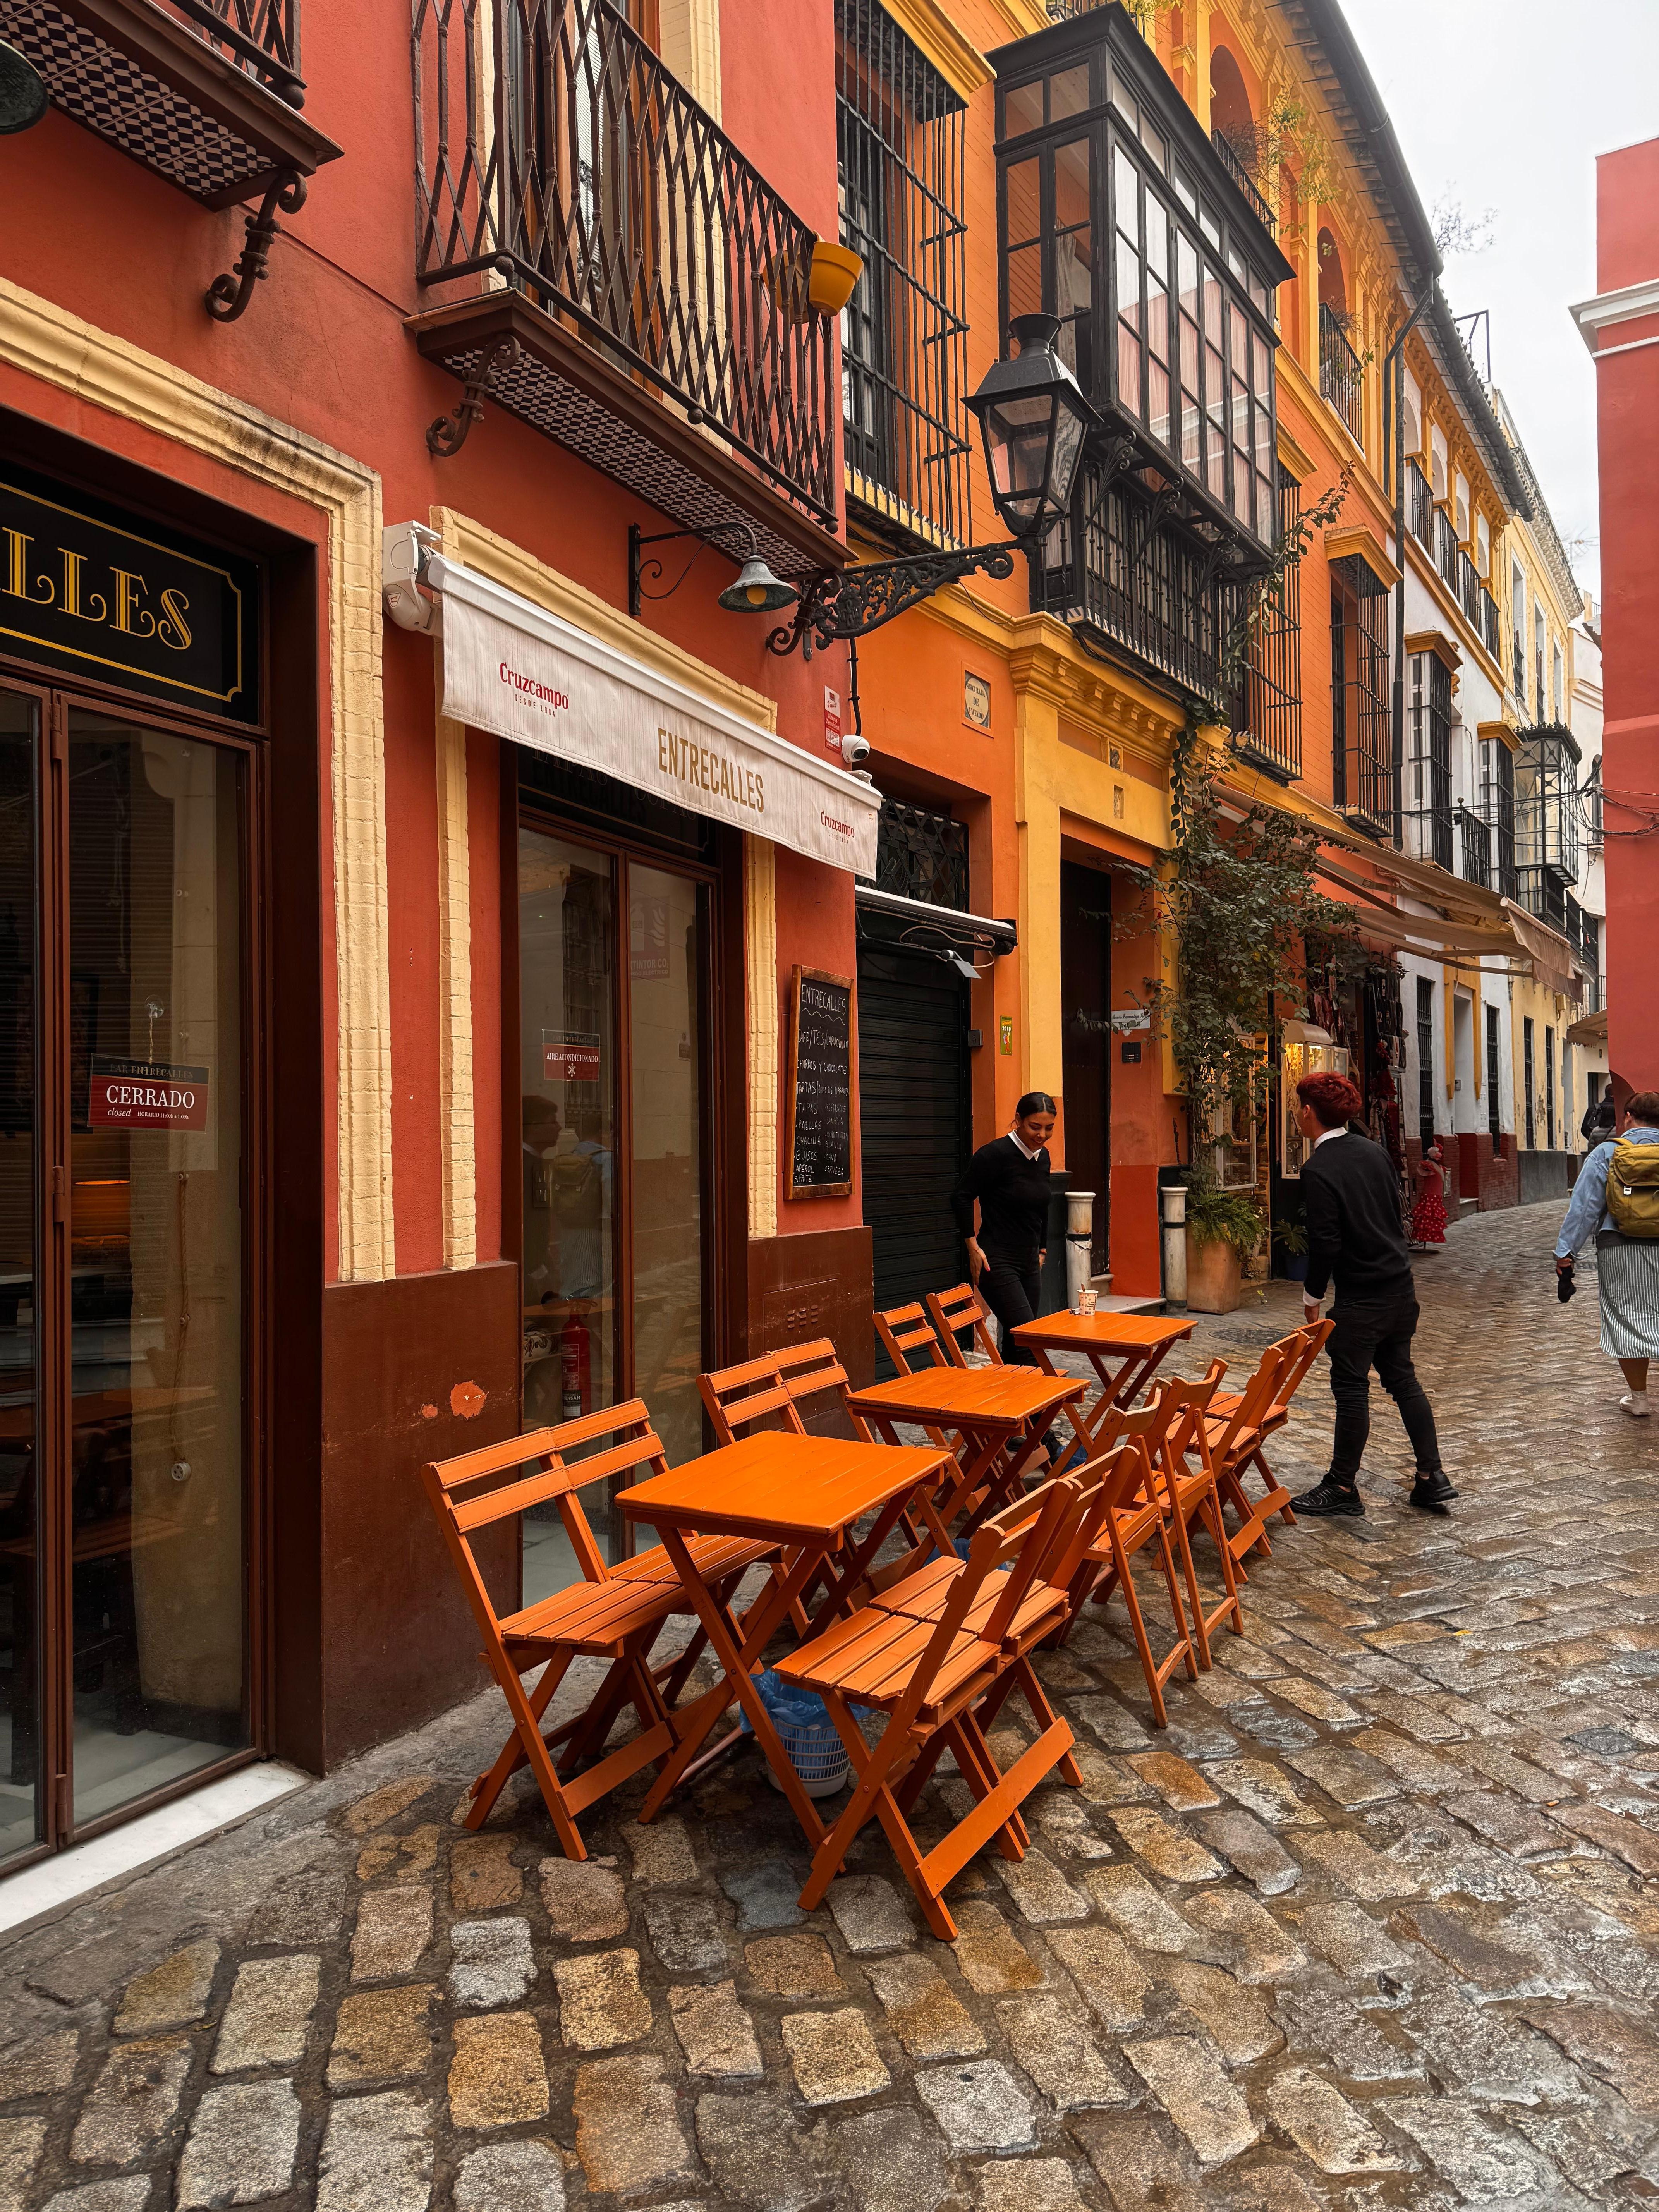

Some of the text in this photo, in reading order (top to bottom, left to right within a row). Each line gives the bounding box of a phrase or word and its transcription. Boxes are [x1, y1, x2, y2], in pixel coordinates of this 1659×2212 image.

[500, 662, 568, 709] Cruzcampo
[515, 694, 536, 709] DESDE
[973, 697, 979, 707] DE
[658, 727, 764, 813] ENTRECALLES
[821, 810, 854, 838] Cruzcampo
[802, 984, 846, 1015] ENTRECALLES
[558, 1053, 598, 1063] ACONDICIONADO
[818, 1061, 823, 1074] Y
[106, 1085, 195, 1109] CERRADO
[107, 1108, 131, 1117] closed
[798, 1102, 817, 1115] TAPAS
[798, 1119, 822, 1130] PAELLAS
[797, 1135, 821, 1146] CHACINA
[826, 1154, 837, 1163] CAVA
[796, 1164, 814, 1173] APEROL
[825, 1165, 844, 1178] CERVEZA
